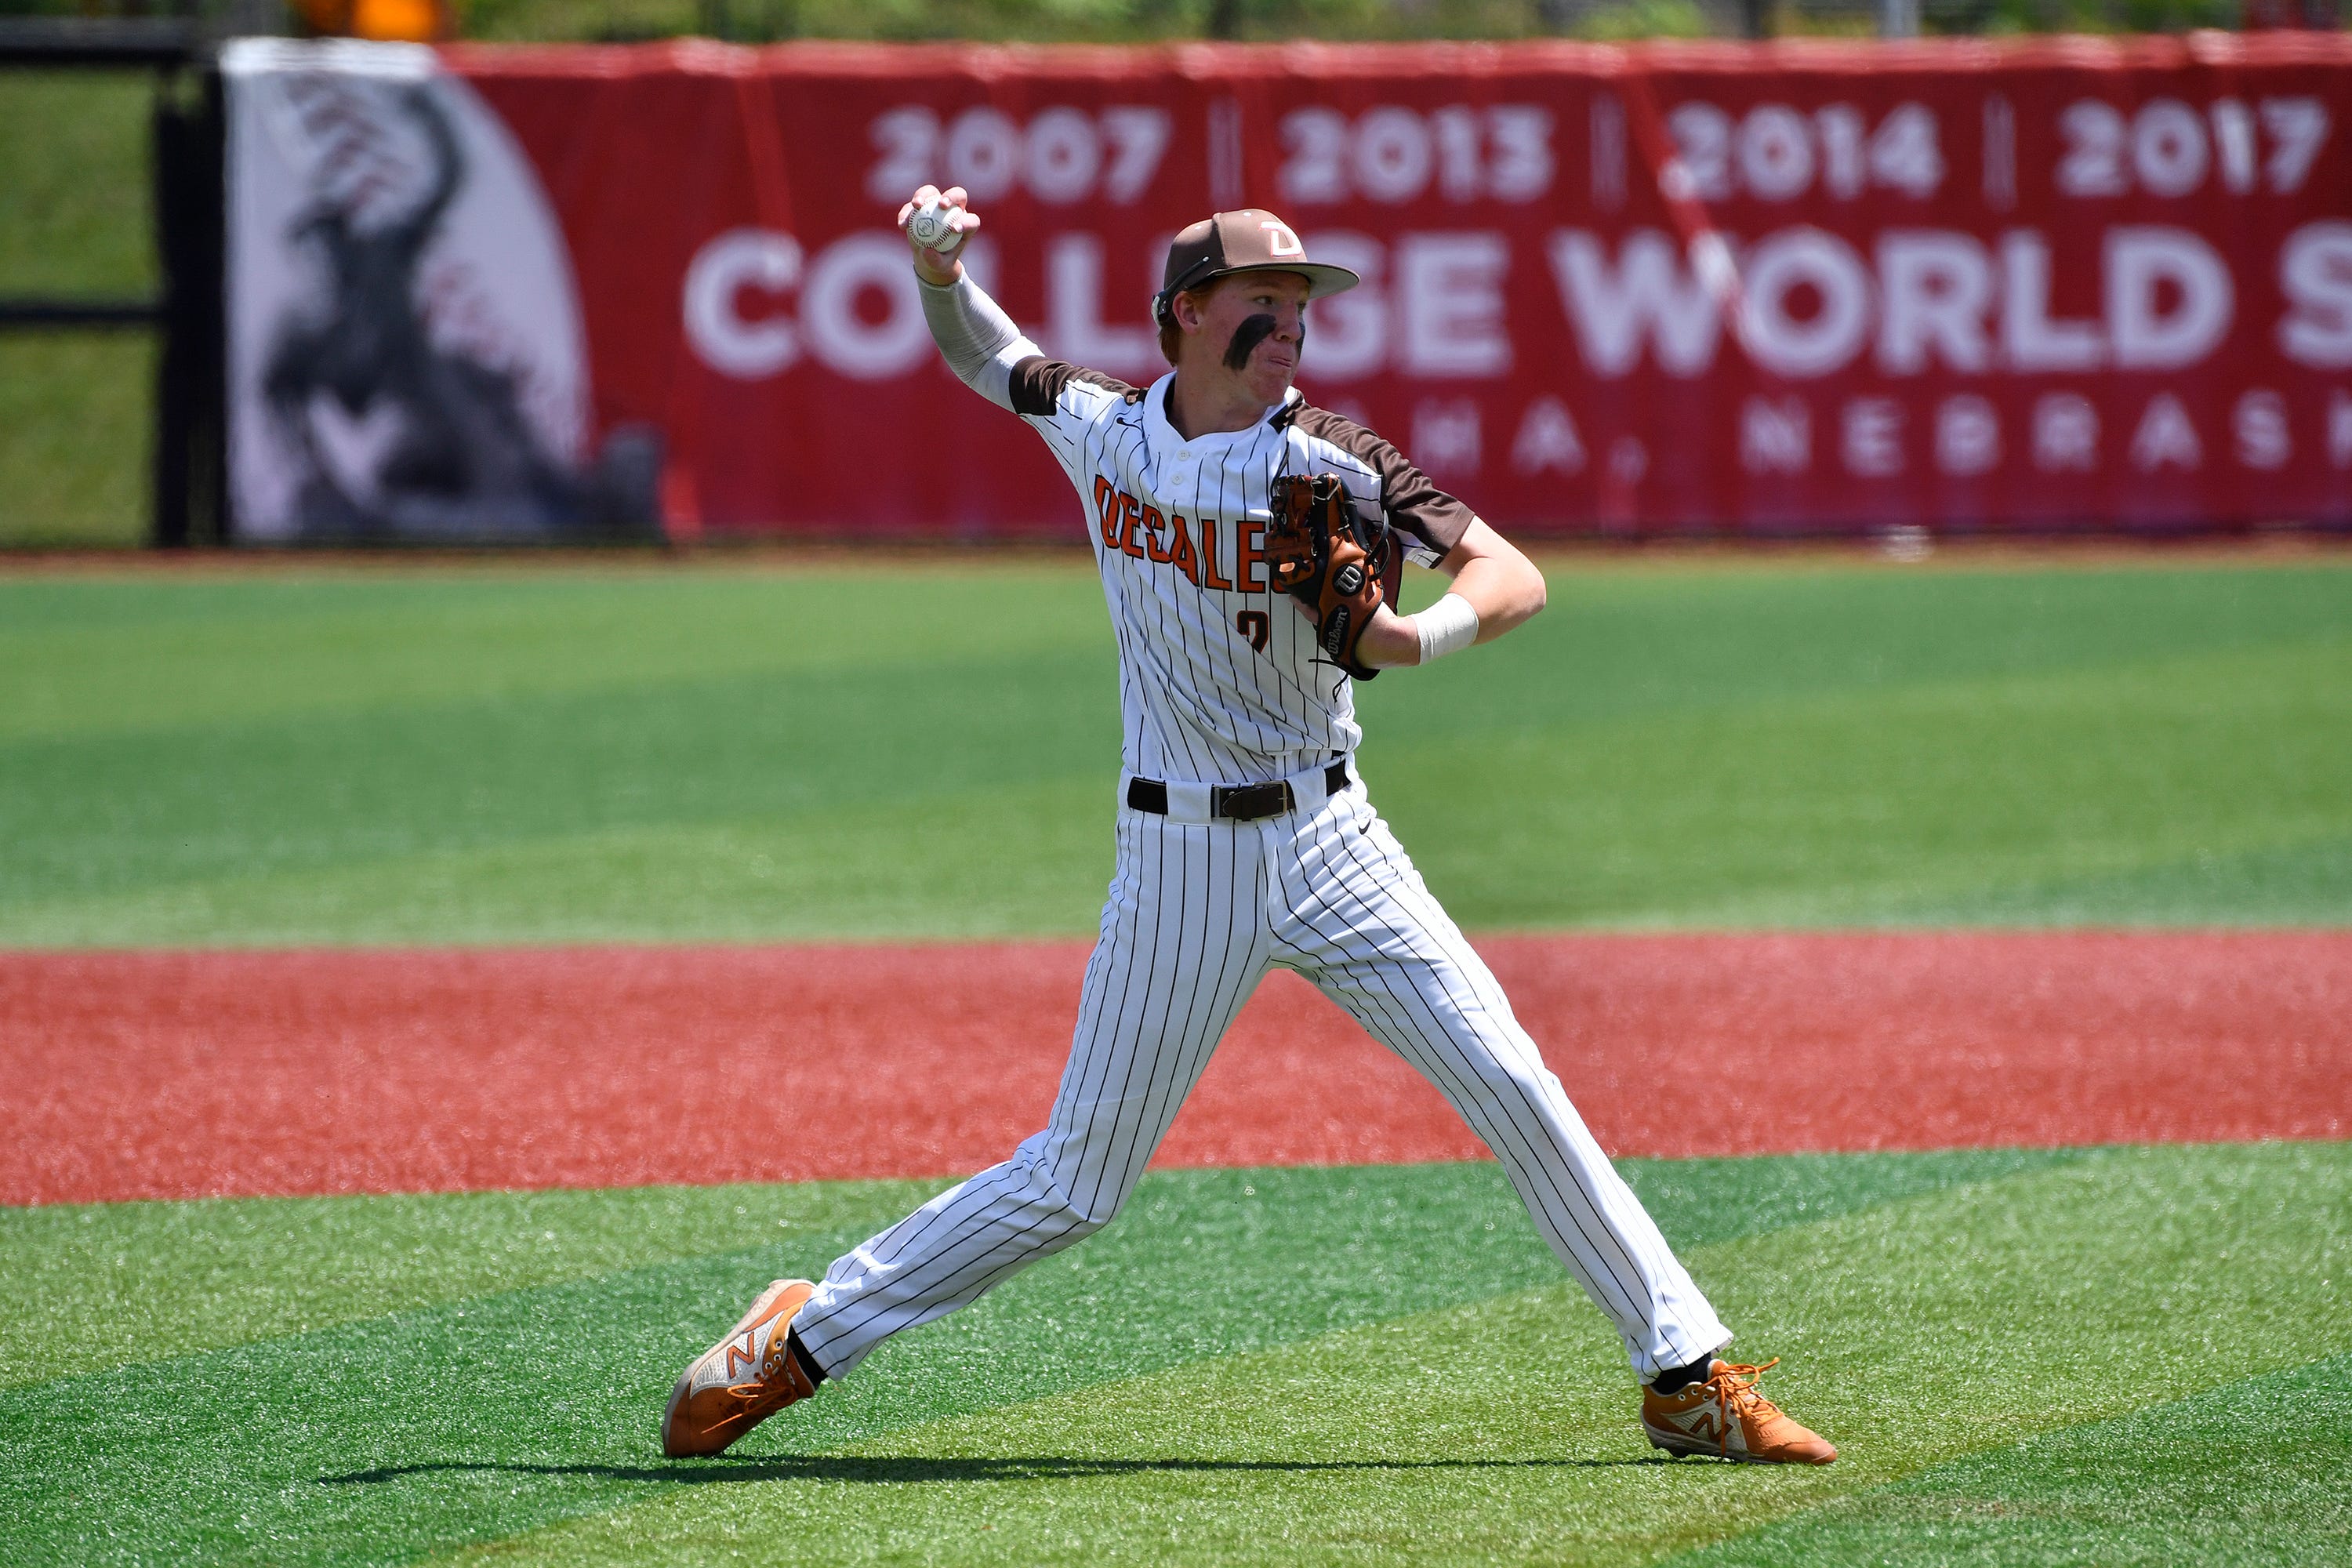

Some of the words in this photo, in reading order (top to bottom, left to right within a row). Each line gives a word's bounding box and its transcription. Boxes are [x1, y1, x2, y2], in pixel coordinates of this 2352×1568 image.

[867, 107, 1170, 205] 2007
[1279, 103, 1554, 204] 2013
[1668, 100, 1941, 201] 2014
[2057, 96, 2327, 198] 2017
[1259, 220, 1302, 257] D
[682, 224, 1512, 383] COLGE
[1551, 223, 2234, 378] WORLD
[1094, 474, 1290, 594] DESALE
